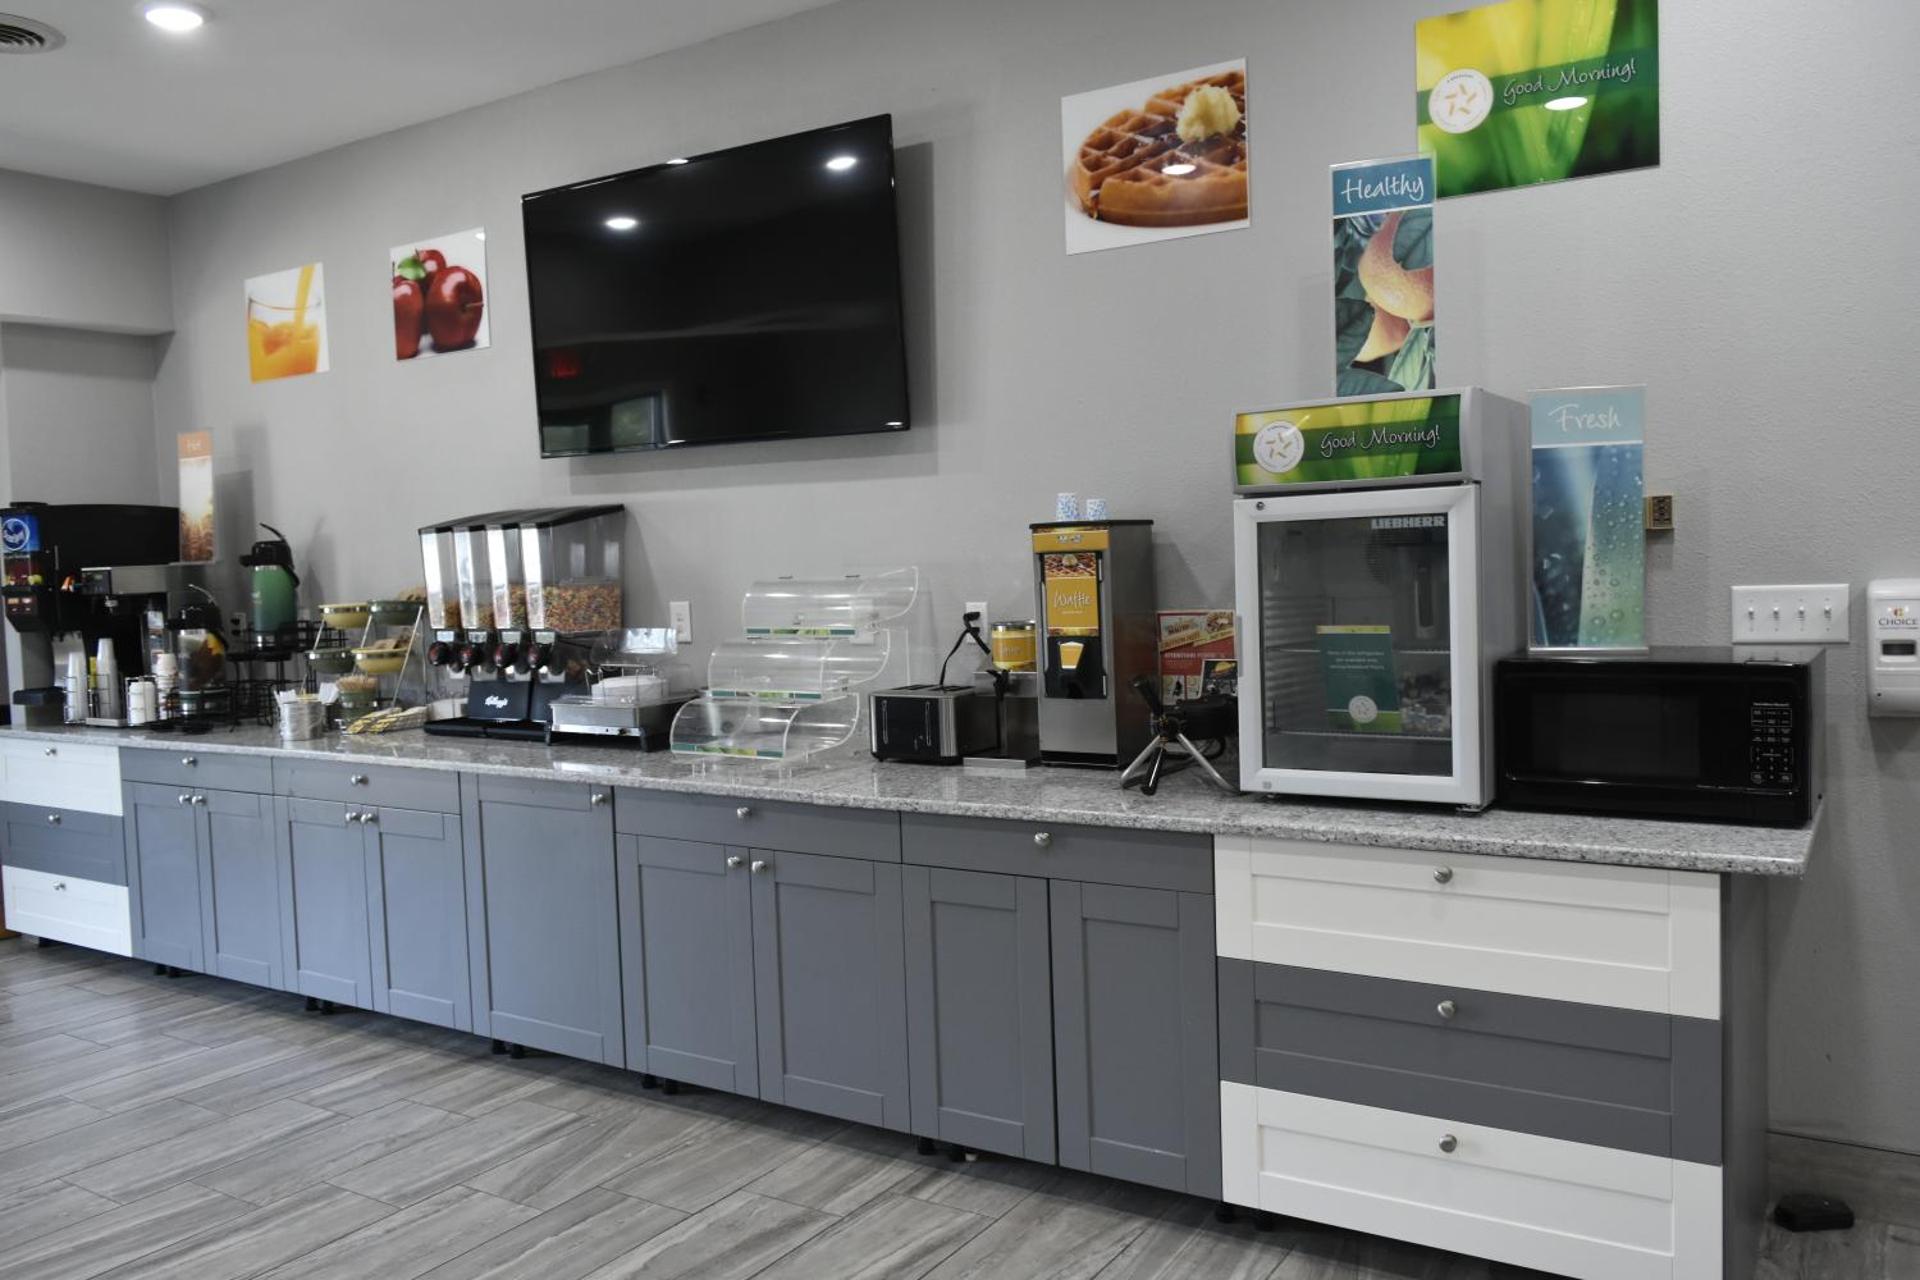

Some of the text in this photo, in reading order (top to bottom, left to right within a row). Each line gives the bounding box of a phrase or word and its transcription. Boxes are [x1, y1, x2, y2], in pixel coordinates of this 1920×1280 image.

[1503, 57, 1637, 106] Good Morning!
[1340, 173, 1424, 204] Healthy
[1547, 403, 1622, 432] Fresh
[1320, 424, 1441, 458] Good Morning!
[1371, 515, 1445, 531] LIEBHERR
[1878, 617, 1918, 626] CHOICE
